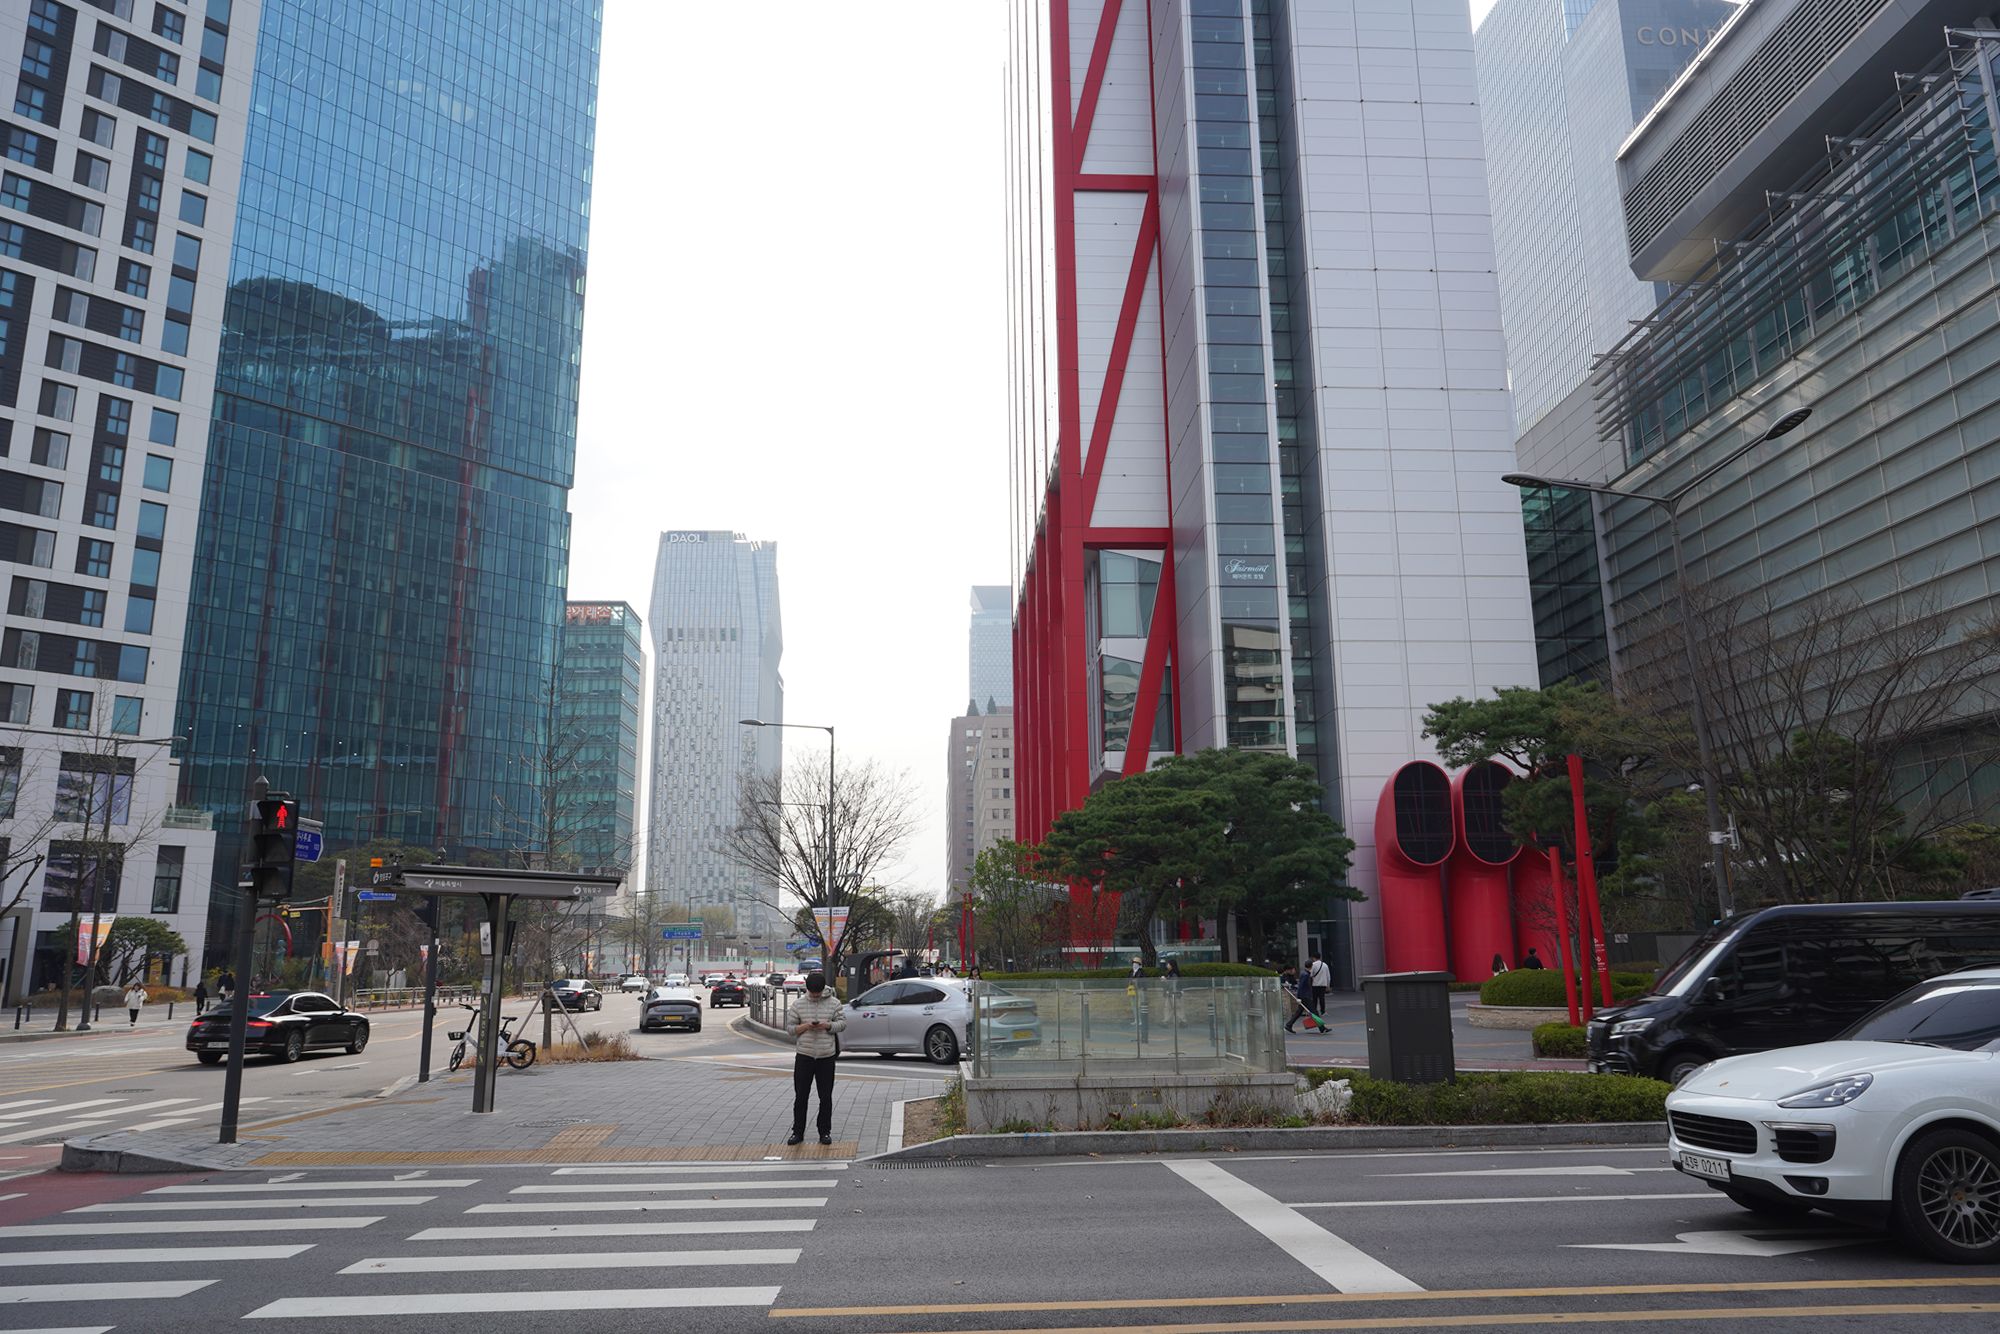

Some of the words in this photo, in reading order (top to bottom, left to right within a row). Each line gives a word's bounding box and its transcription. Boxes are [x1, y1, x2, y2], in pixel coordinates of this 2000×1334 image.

[670, 533, 704, 543] DAOL
[1224, 558, 1269, 573] Fairmont
[1701, 1159, 1724, 1175] 0211
